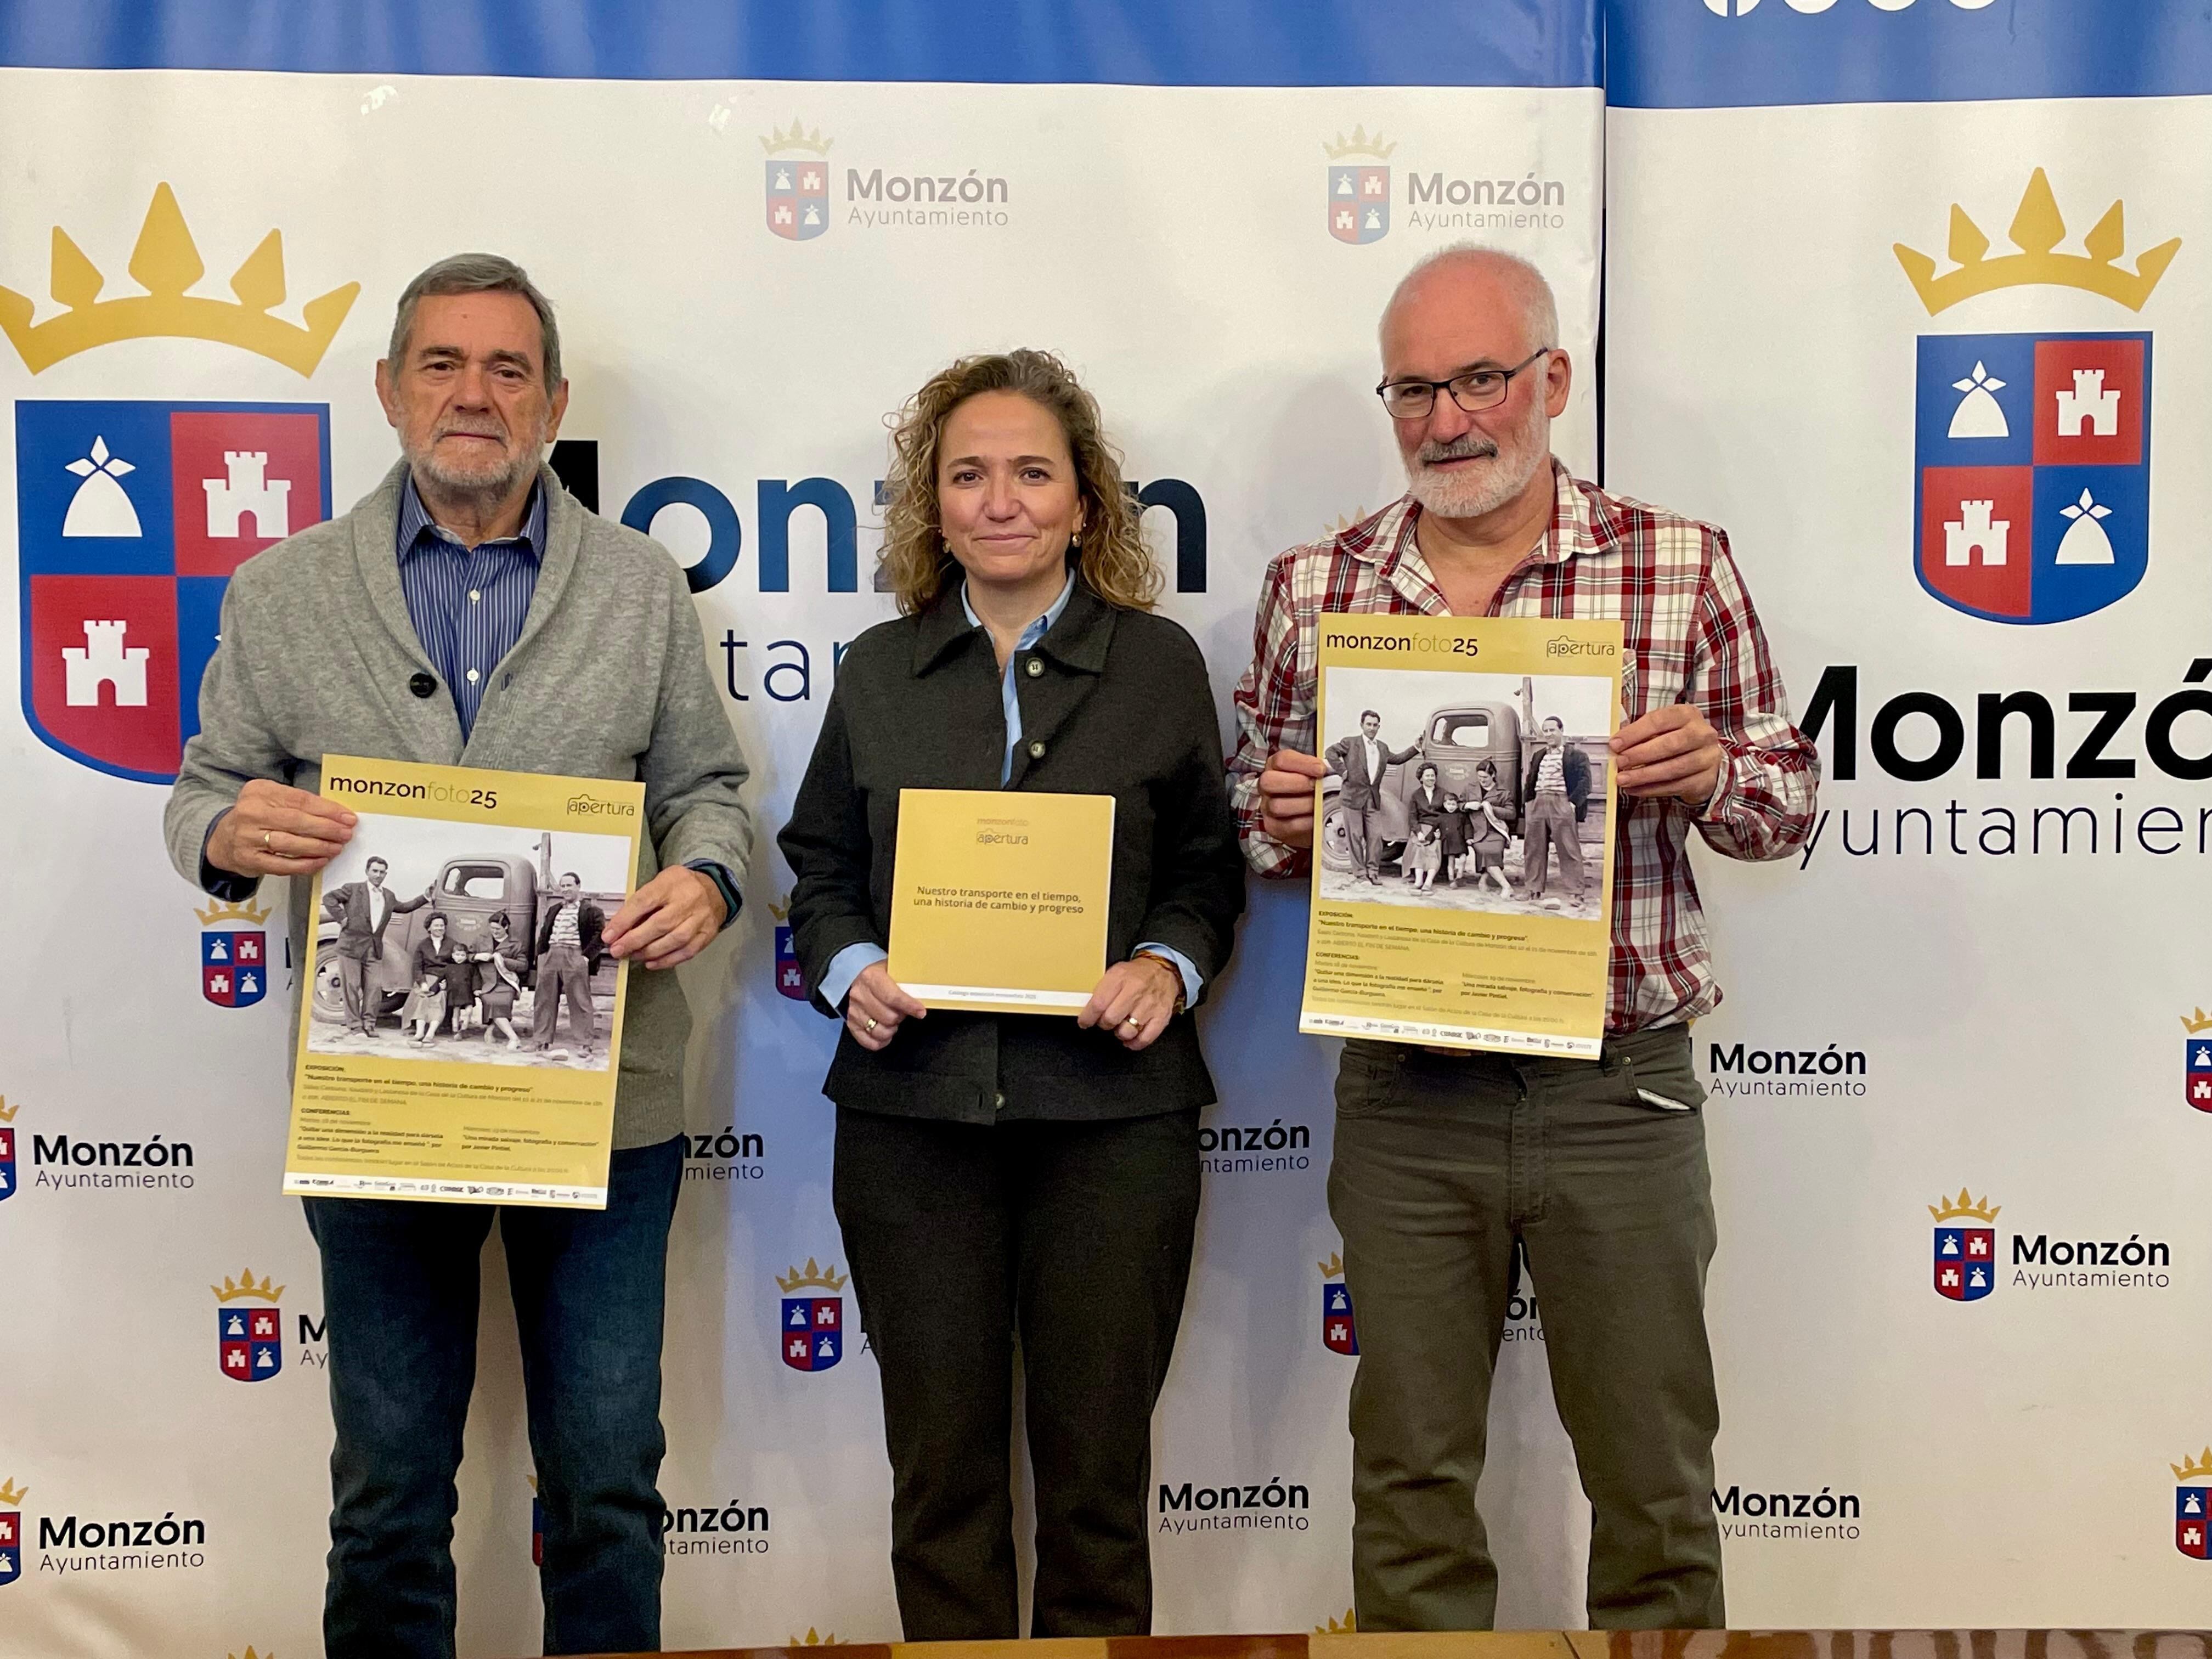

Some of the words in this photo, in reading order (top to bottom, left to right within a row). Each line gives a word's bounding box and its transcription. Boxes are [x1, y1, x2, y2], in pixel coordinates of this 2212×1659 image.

[847, 168, 1008, 202] Monzón
[1408, 171, 1564, 205] Monzón
[848, 206, 1008, 228] Ayuntamiento
[1408, 210, 1564, 231] Ayuntamiento
[548, 440, 1206, 594] onn
[1327, 632, 1478, 656] monzonfoto25
[1549, 642, 1615, 657] apertura
[330, 777, 497, 809] monzonfoto25
[569, 801, 635, 816] apertura
[977, 832, 1029, 845] apertura
[917, 886, 957, 896] Nuestro
[960, 889, 1013, 899] transporte
[1031, 891, 1040, 900] el
[1042, 893, 1081, 903] tiempo,
[934, 898, 973, 909] historia
[975, 900, 988, 909] de
[991, 901, 1028, 911] cambio
[1030, 904, 1036, 913] y
[1038, 904, 1084, 915] progreso
[1711, 1043, 1865, 1075] Monzón
[1711, 1078, 1866, 1098] Ayuntamiento
[33, 1135, 193, 1166] Monzón
[35, 1170, 194, 1190] Ayuntamiento
[2013, 1234, 2169, 1266] Monzón
[2013, 1269, 2169, 1290] Ayuntamiento
[1159, 1476, 1308, 1513] Monzón
[1711, 1486, 1859, 1518] Monzón
[40, 1512, 205, 1549] Monzón
[1159, 1511, 1308, 1535] Ayuntamiento
[1722, 1522, 1859, 1539] yuntamiento
[664, 1537, 769, 1555] tamiento
[40, 1551, 204, 1575] Ayuntamiento
